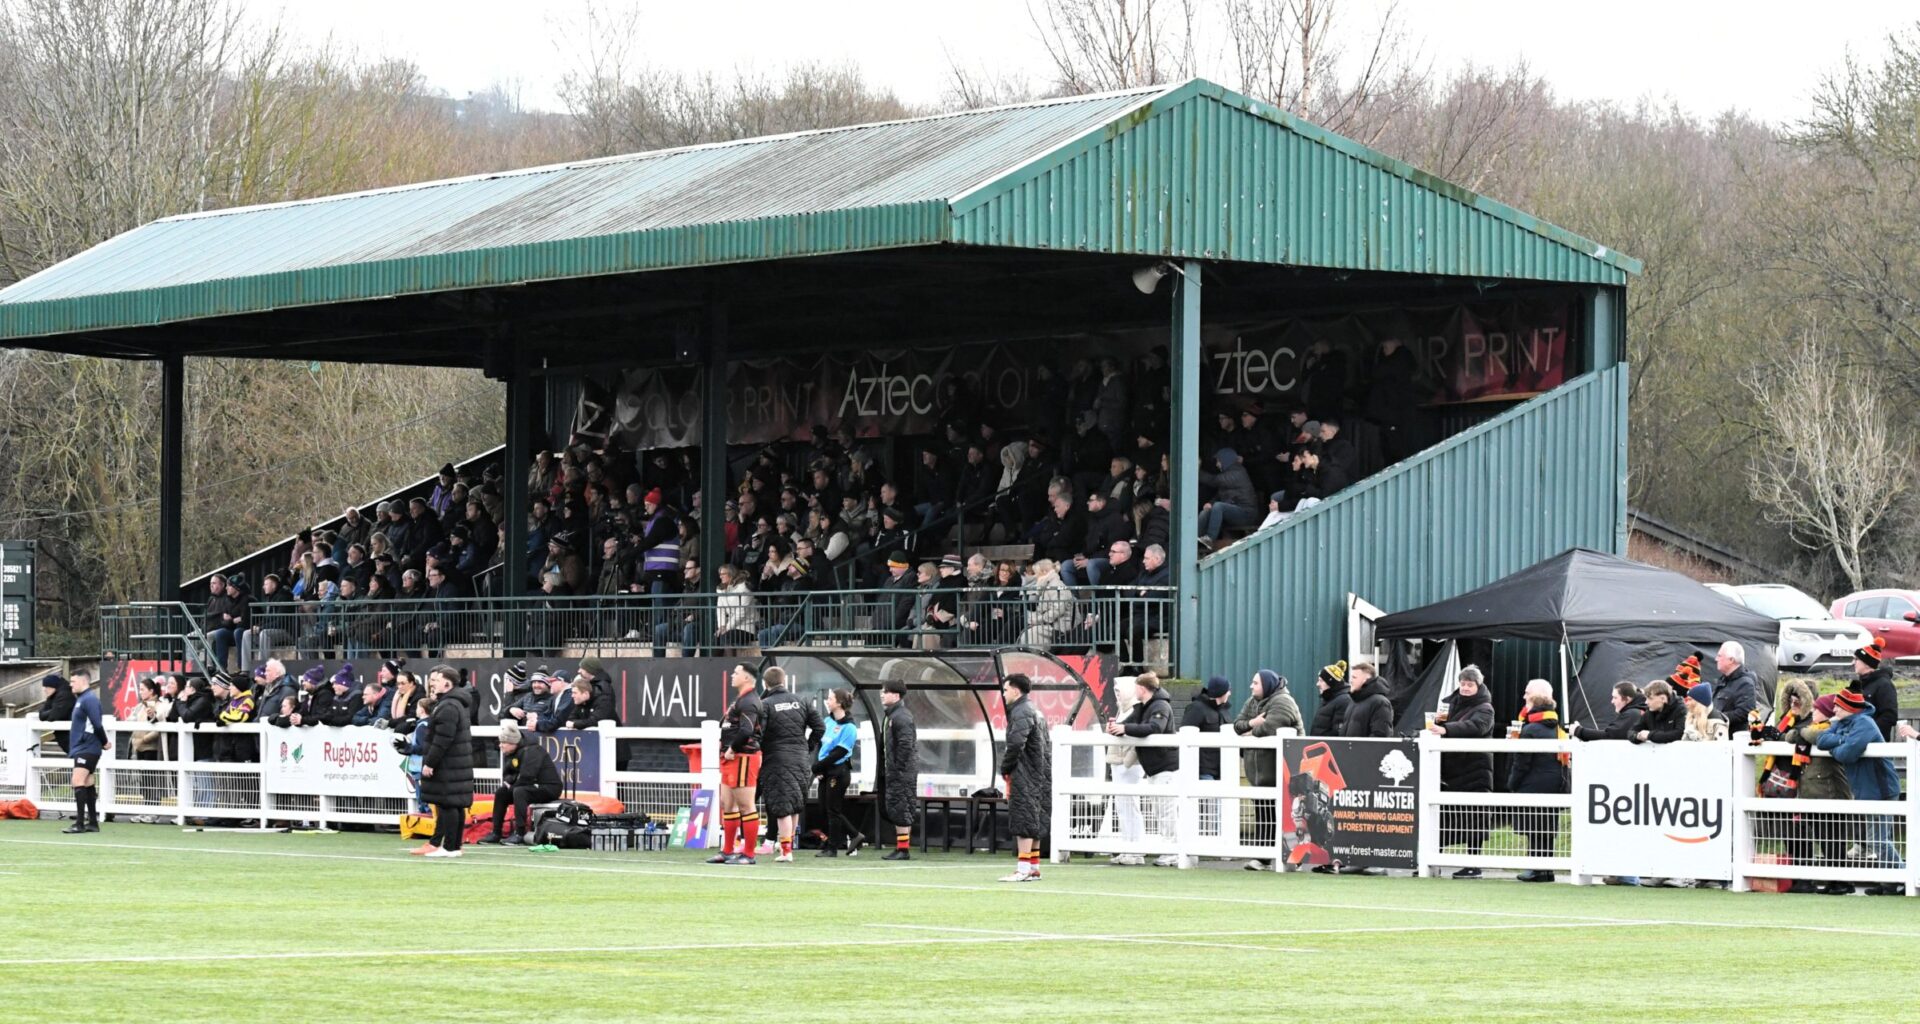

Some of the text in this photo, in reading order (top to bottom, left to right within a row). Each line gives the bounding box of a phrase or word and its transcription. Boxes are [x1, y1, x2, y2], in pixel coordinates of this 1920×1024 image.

[1213, 336, 1297, 394] ztec
[1464, 326, 1560, 377] PRINT
[744, 382, 815, 424] PRINT
[837, 363, 933, 418] Aztec
[641, 674, 708, 717] MAIL
[323, 741, 378, 768] Rugby365
[1333, 789, 1415, 810] FOREST MASTER
[1333, 810, 1415, 822] AWARD-WINNING GARDEN
[1588, 783, 1723, 840] Bellway
[1337, 823, 1414, 834] & FORESTRY EQUIPMENT
[1332, 845, 1414, 858] www.forest-master.com
